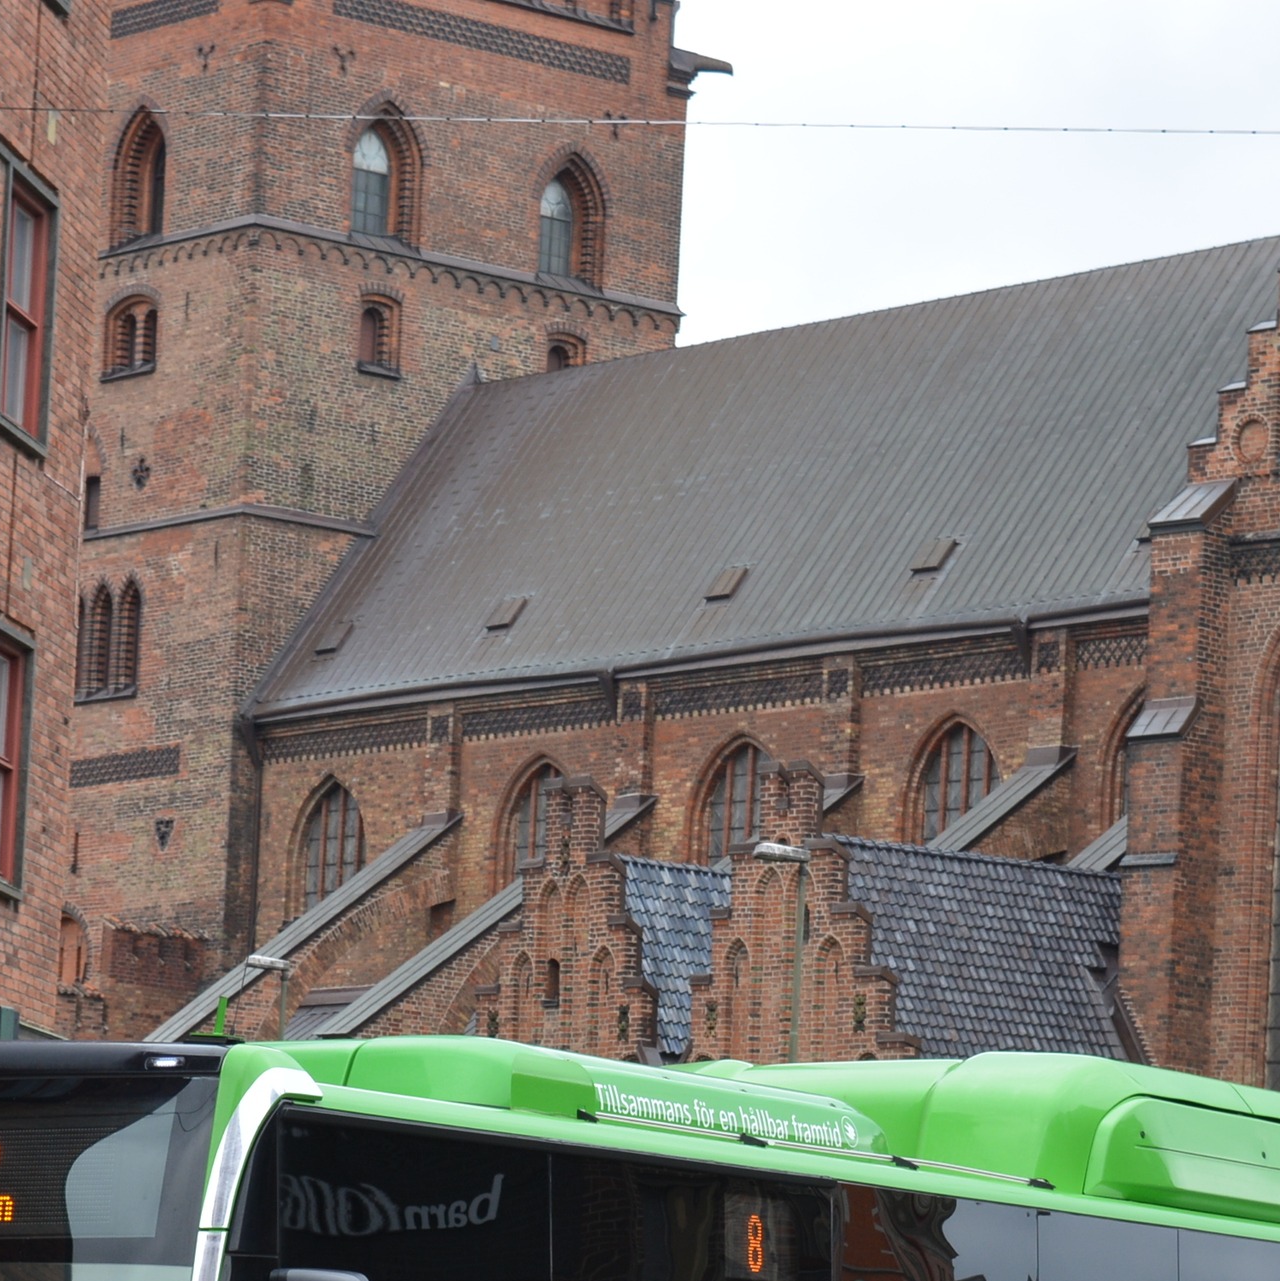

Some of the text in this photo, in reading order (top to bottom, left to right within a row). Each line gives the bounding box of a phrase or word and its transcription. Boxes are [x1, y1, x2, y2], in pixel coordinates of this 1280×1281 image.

[594, 1083, 842, 1148] Tillsammans för en hållbar framtid
[747, 1214, 763, 1273] 8
